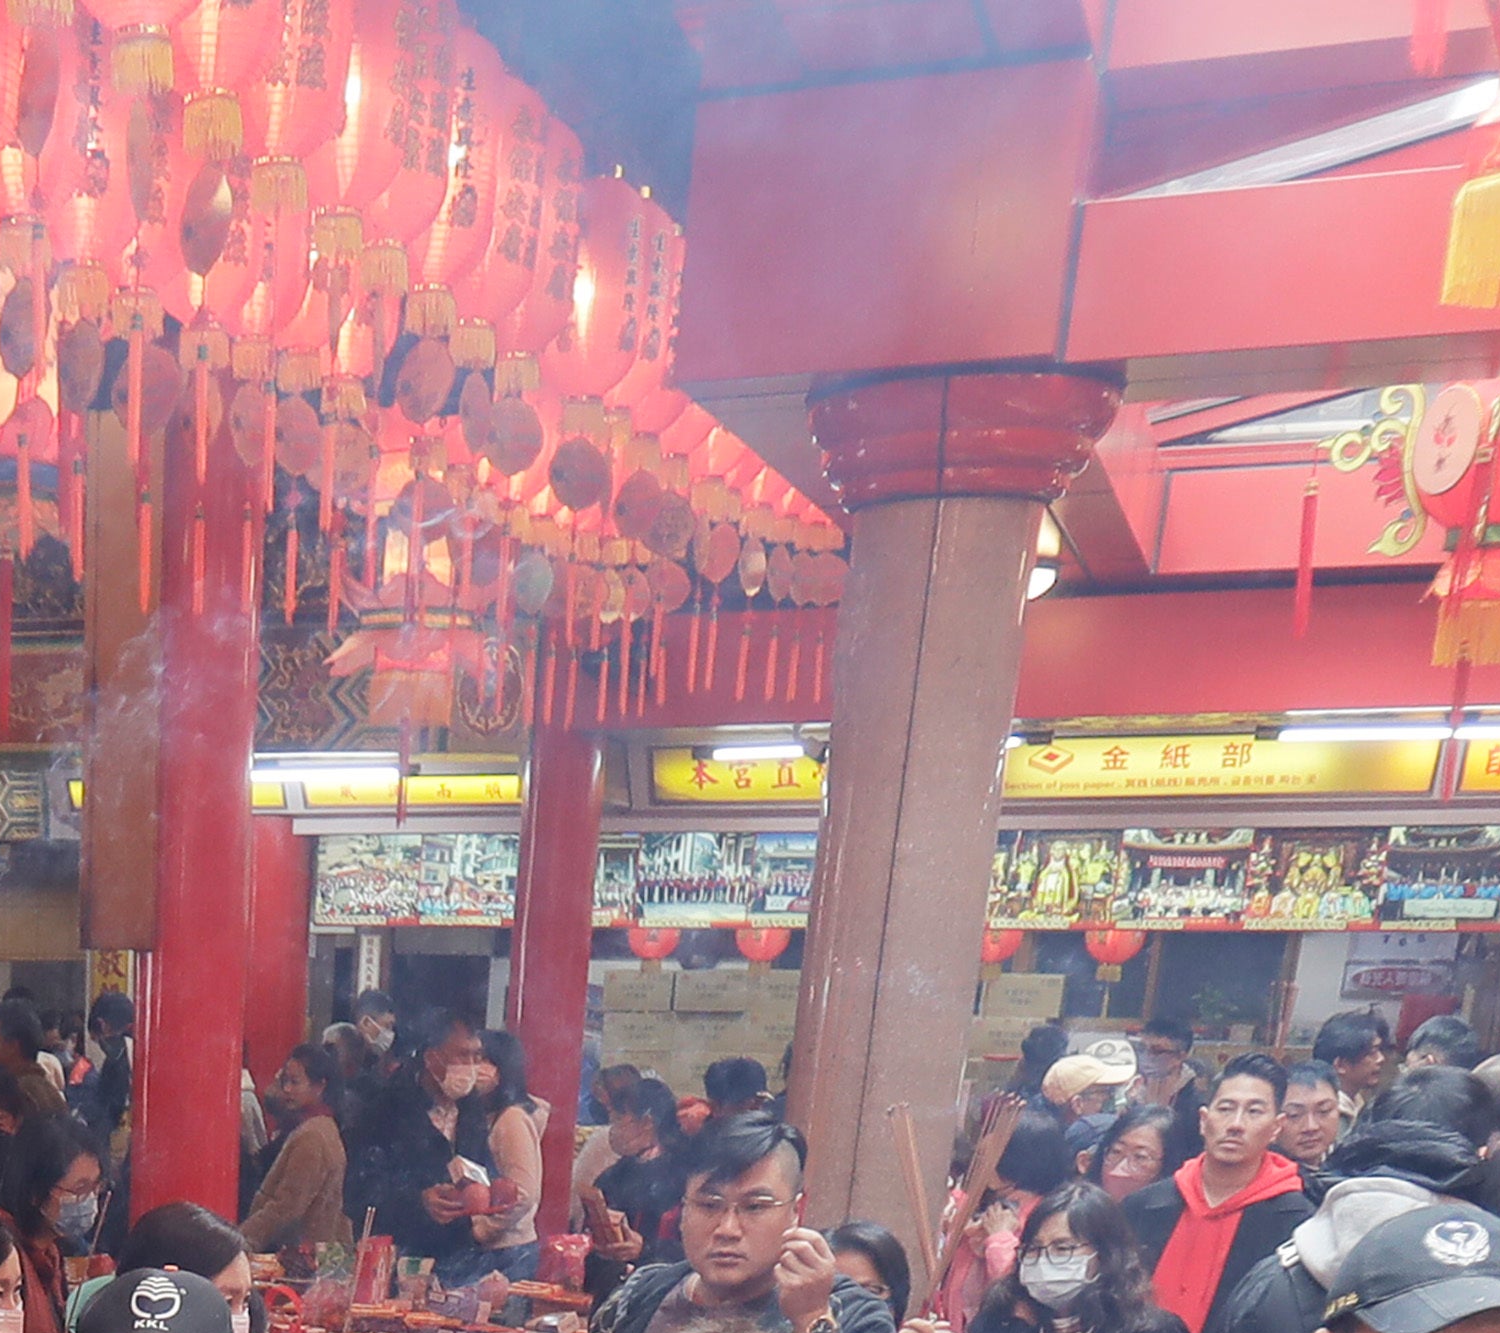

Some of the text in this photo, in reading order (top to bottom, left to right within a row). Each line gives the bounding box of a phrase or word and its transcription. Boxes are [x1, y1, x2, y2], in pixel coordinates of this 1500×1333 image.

[1100, 741, 1254, 771] 金紙部
[690, 758, 824, 790] 本宮直
[133, 1319, 170, 1331] KKL
